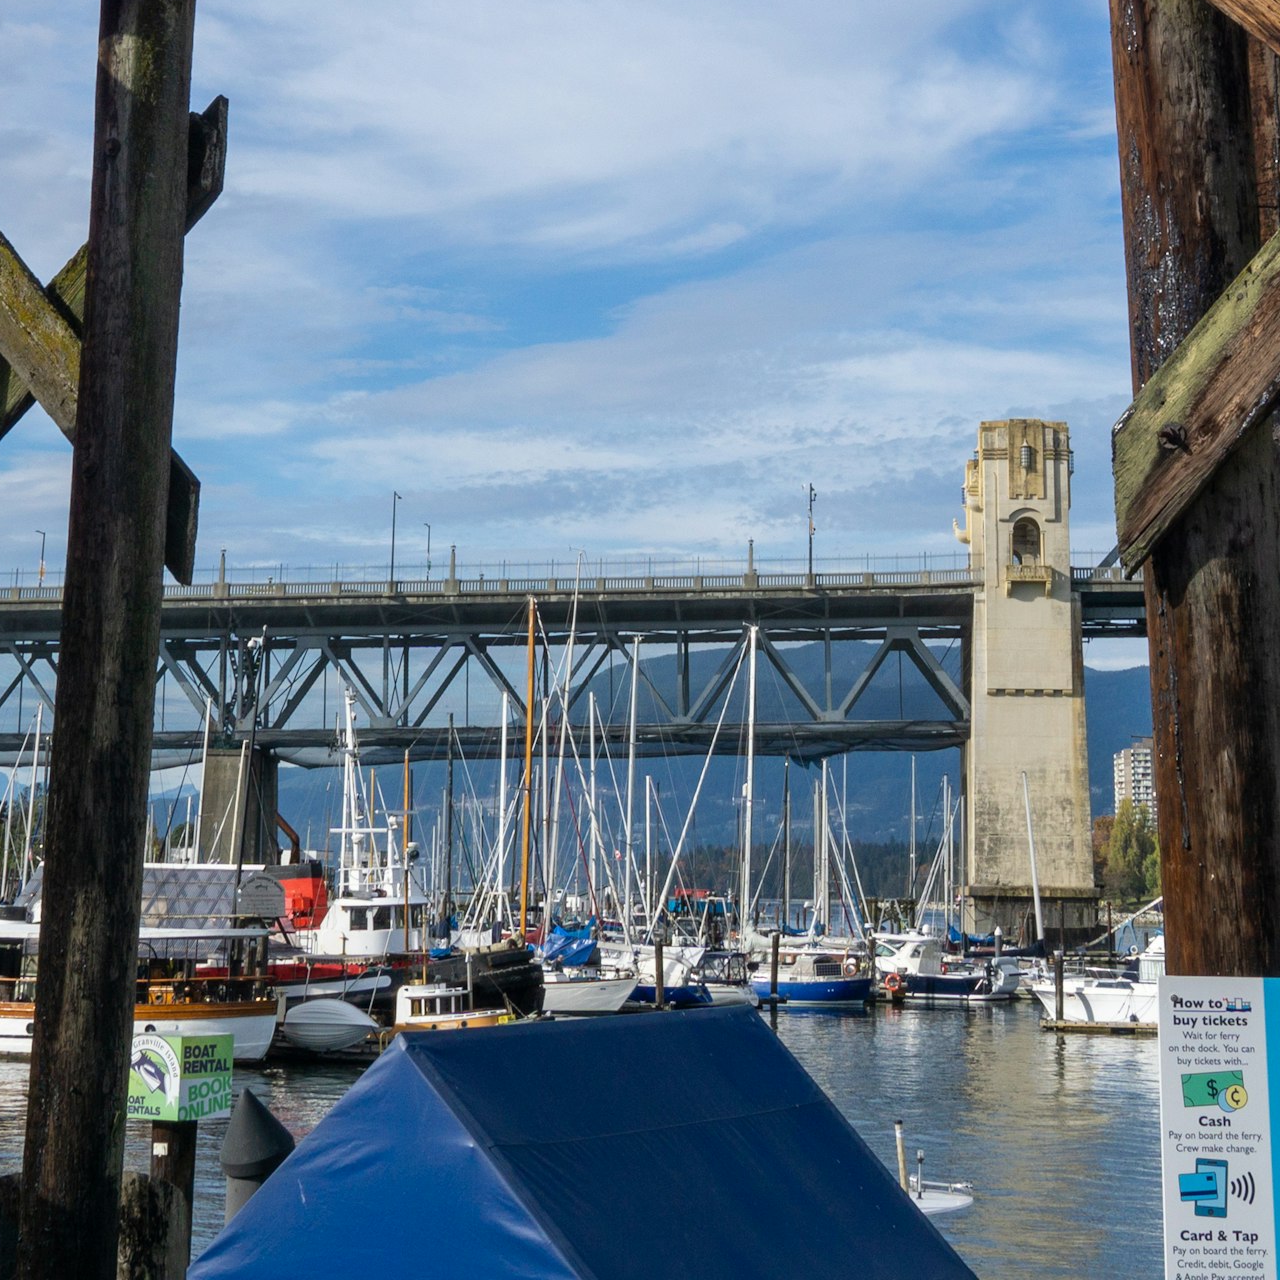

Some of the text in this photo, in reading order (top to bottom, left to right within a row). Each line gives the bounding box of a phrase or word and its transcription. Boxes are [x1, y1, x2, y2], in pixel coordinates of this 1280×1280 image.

[1173, 998, 1223, 1008] How to
[1173, 1015, 1248, 1028] buy tickets
[1182, 1031, 1240, 1042] Wait for ferry
[184, 1044, 217, 1059] BOAT
[1182, 1044, 1195, 1052] the
[1198, 1044, 1220, 1052] dock.
[1223, 1045, 1239, 1053] You
[133, 1039, 178, 1078] Granville Island
[1177, 1057, 1191, 1067] buy
[1195, 1057, 1221, 1065] tickets
[183, 1058, 230, 1074] RENTAL
[188, 1076, 232, 1102] BOOK
[128, 1095, 146, 1104] OAT
[127, 1106, 161, 1115] ENTALS
[178, 1093, 232, 1120] ONLINE
[1198, 1115, 1231, 1127] Cash
[1168, 1130, 1182, 1141] Pay
[1198, 1131, 1223, 1140] board
[1225, 1132, 1239, 1140] the
[1241, 1132, 1263, 1142] ferry.
[1176, 1144, 1257, 1155] Crew make change.
[1180, 1230, 1259, 1245] Card & Tap
[1172, 1246, 1186, 1257] Pay
[1203, 1246, 1227, 1255] board
[1230, 1247, 1244, 1255] the
[1246, 1247, 1268, 1258] ferry.
[1177, 1259, 1264, 1271] Credit, debit, Google
